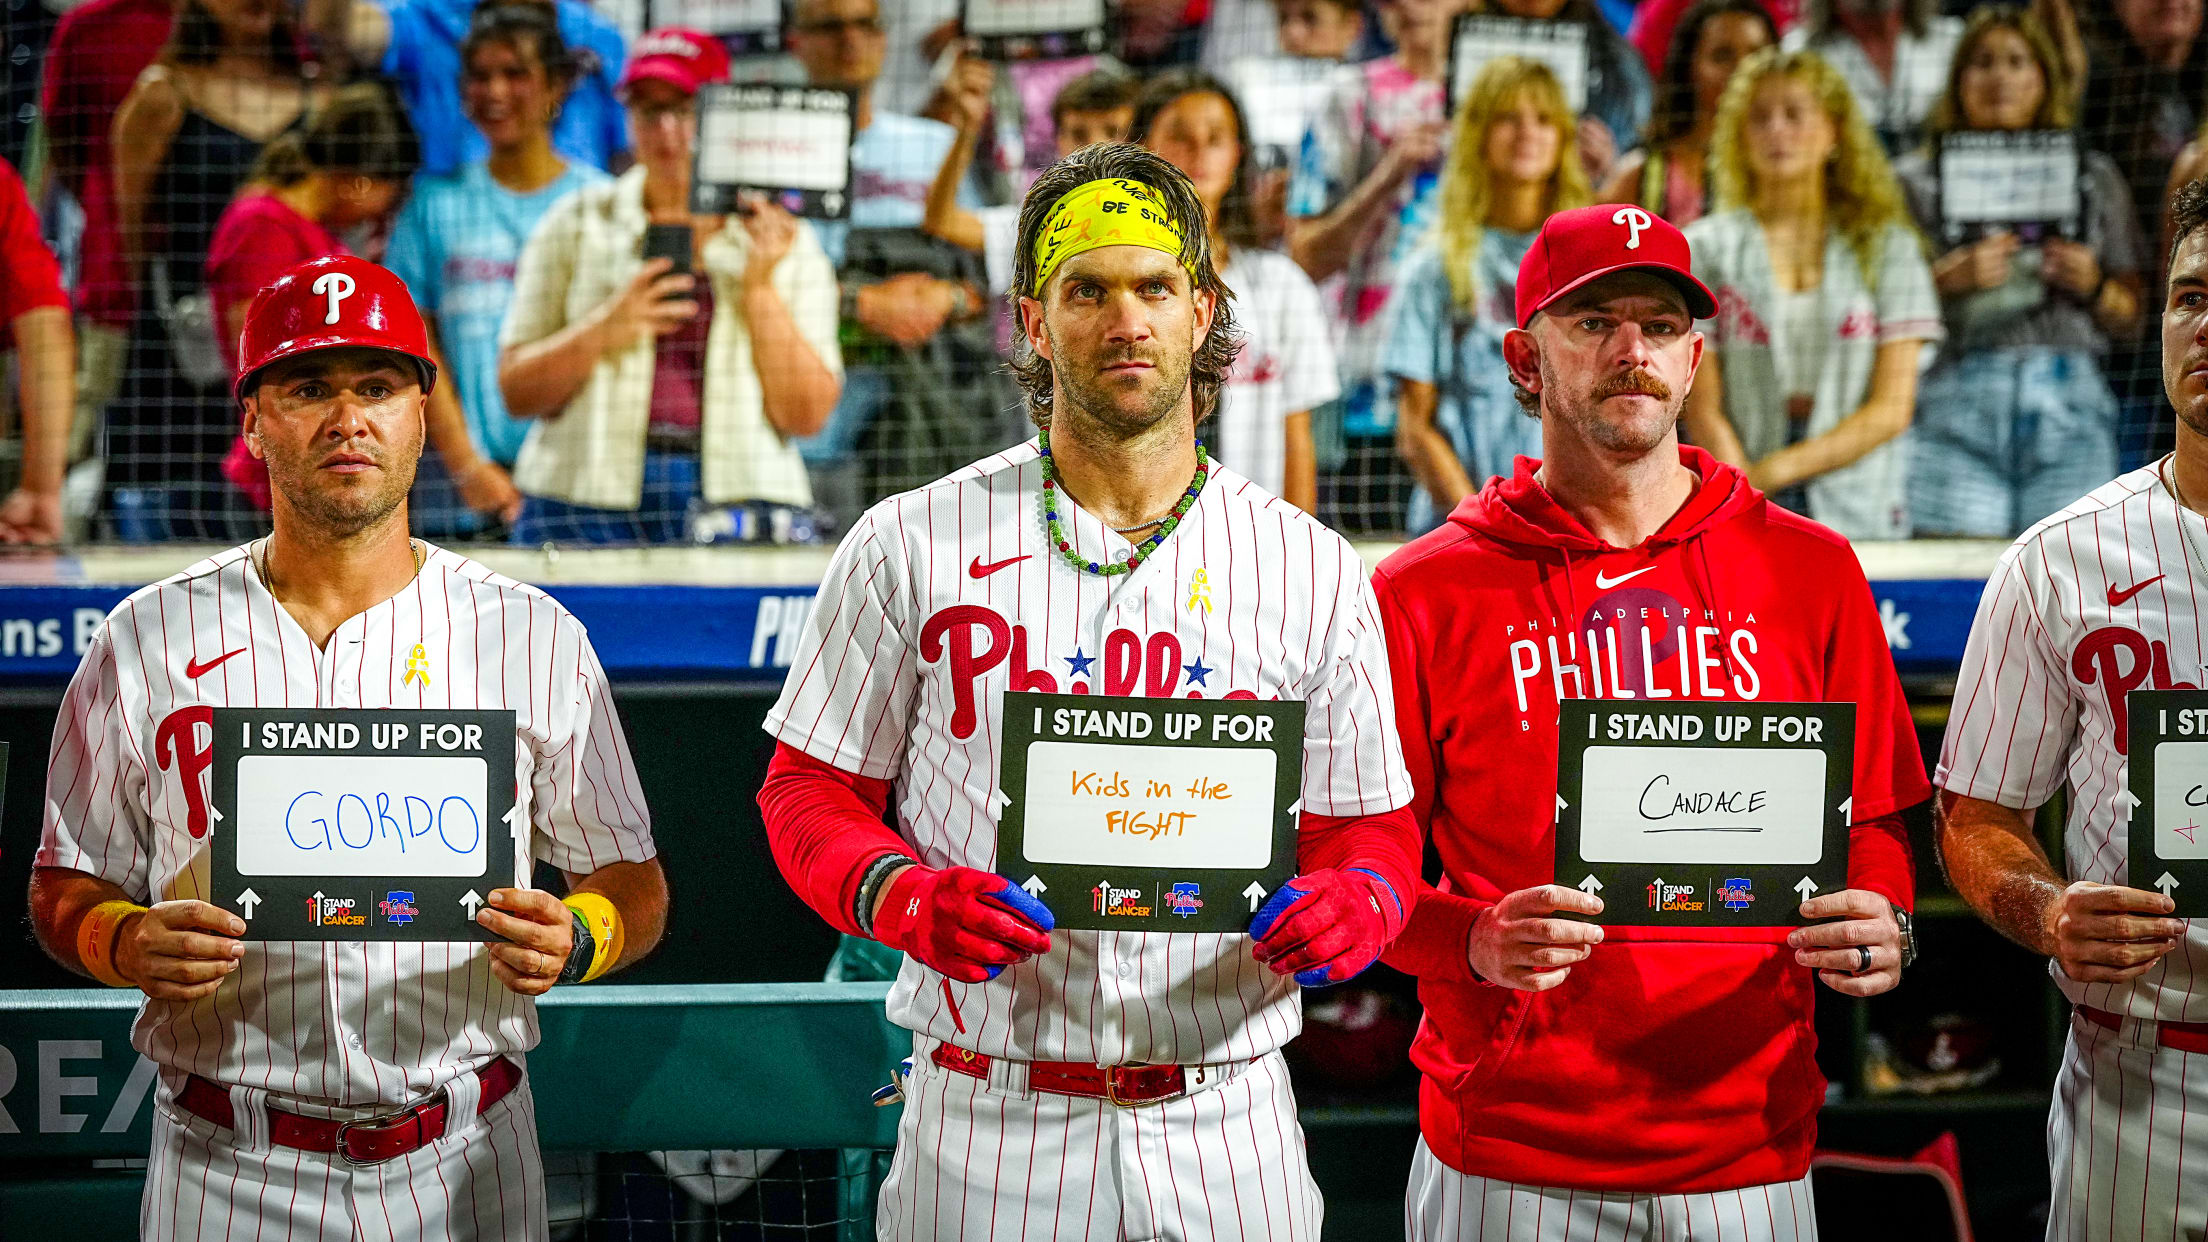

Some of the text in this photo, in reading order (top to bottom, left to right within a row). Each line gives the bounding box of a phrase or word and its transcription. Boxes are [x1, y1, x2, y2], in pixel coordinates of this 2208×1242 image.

[1102, 200, 1129, 214] BE
[1612, 208, 1652, 250] P
[312, 272, 356, 325] P
[1509, 625, 1761, 712] PHILLIES
[1033, 707, 1274, 742] I STAND UP FOR
[1588, 714, 1824, 742] I STAND UP FOR
[2159, 709, 2167, 735] I
[242, 722, 483, 750] I STAND UP FOR
[1071, 770, 1233, 800] Kids in the
[286, 791, 479, 854] GORDO
[1106, 811, 1197, 841] FIGHT
[1109, 888, 1141, 899] STAND
[1164, 892, 1204, 908] Phillies
[1663, 885, 1694, 895] STAND
[1716, 888, 1756, 902] Phillies
[323, 898, 355, 908] STAND
[379, 901, 420, 916] Phillies
[1107, 906, 1150, 916] CANCER
[1662, 902, 1703, 911] CANCER
[323, 916, 365, 926] CANCER
